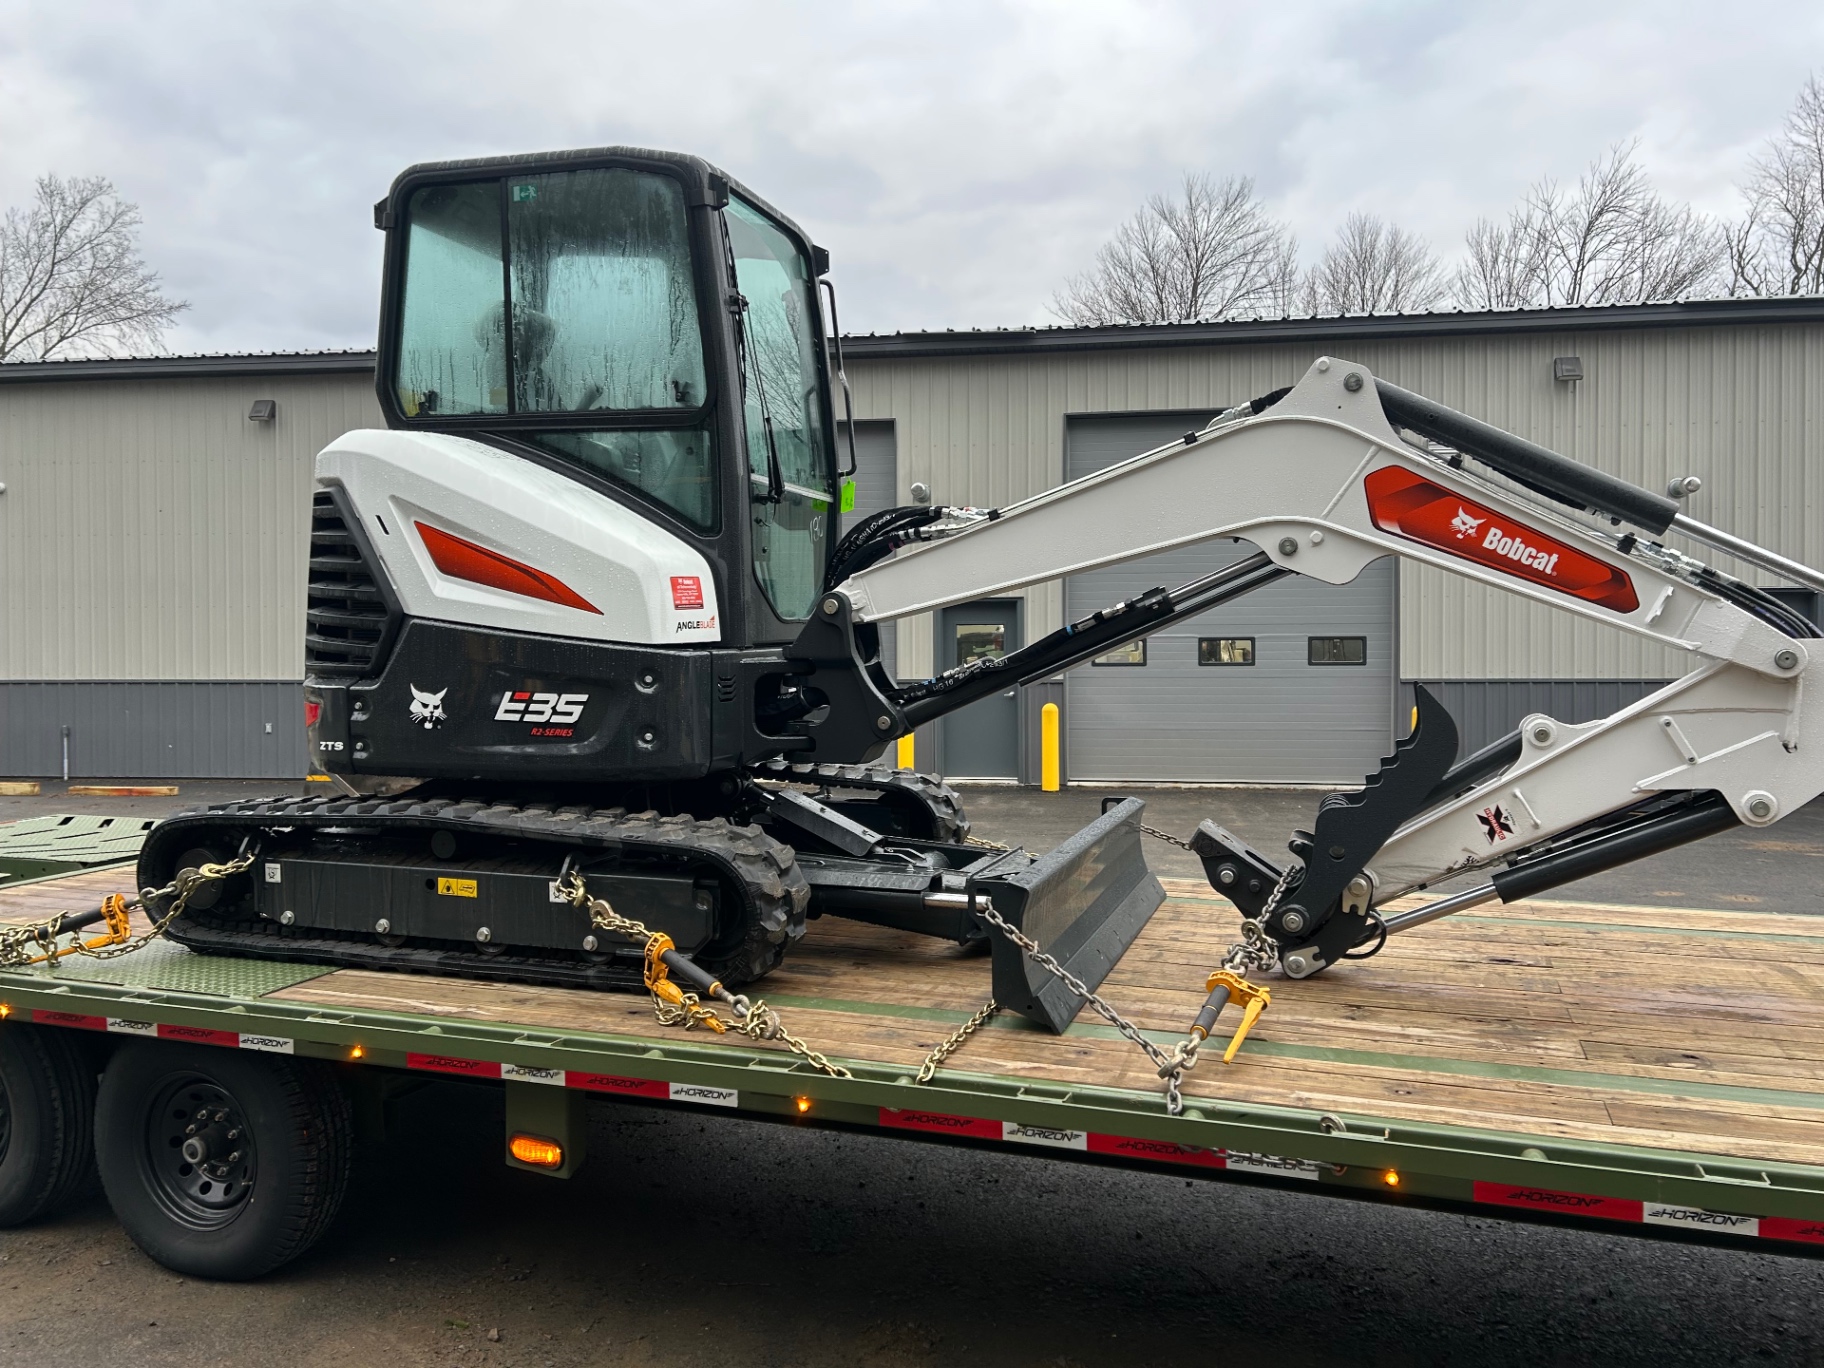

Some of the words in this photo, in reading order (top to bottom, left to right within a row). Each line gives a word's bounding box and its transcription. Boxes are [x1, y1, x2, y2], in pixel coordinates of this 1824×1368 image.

[1482, 527, 1559, 575] Bobcat
[676, 619, 716, 633] ANGLEBLADE
[494, 691, 589, 723] E35
[530, 727, 574, 737] R2-SERIES
[320, 741, 344, 751] ZTS
[246, 1036, 285, 1048] HORIZON
[431, 1057, 476, 1069] HORIZON
[510, 1067, 557, 1079] HORIZON
[592, 1076, 641, 1088] HORIZON
[678, 1087, 730, 1100] HORIZON
[910, 1113, 966, 1128] HORIZON
[1016, 1127, 1074, 1142] HORIZON
[1125, 1141, 1185, 1155] HORIZON
[1517, 1190, 1595, 1208] HORIZON
[1659, 1208, 1742, 1226] HORIZON
